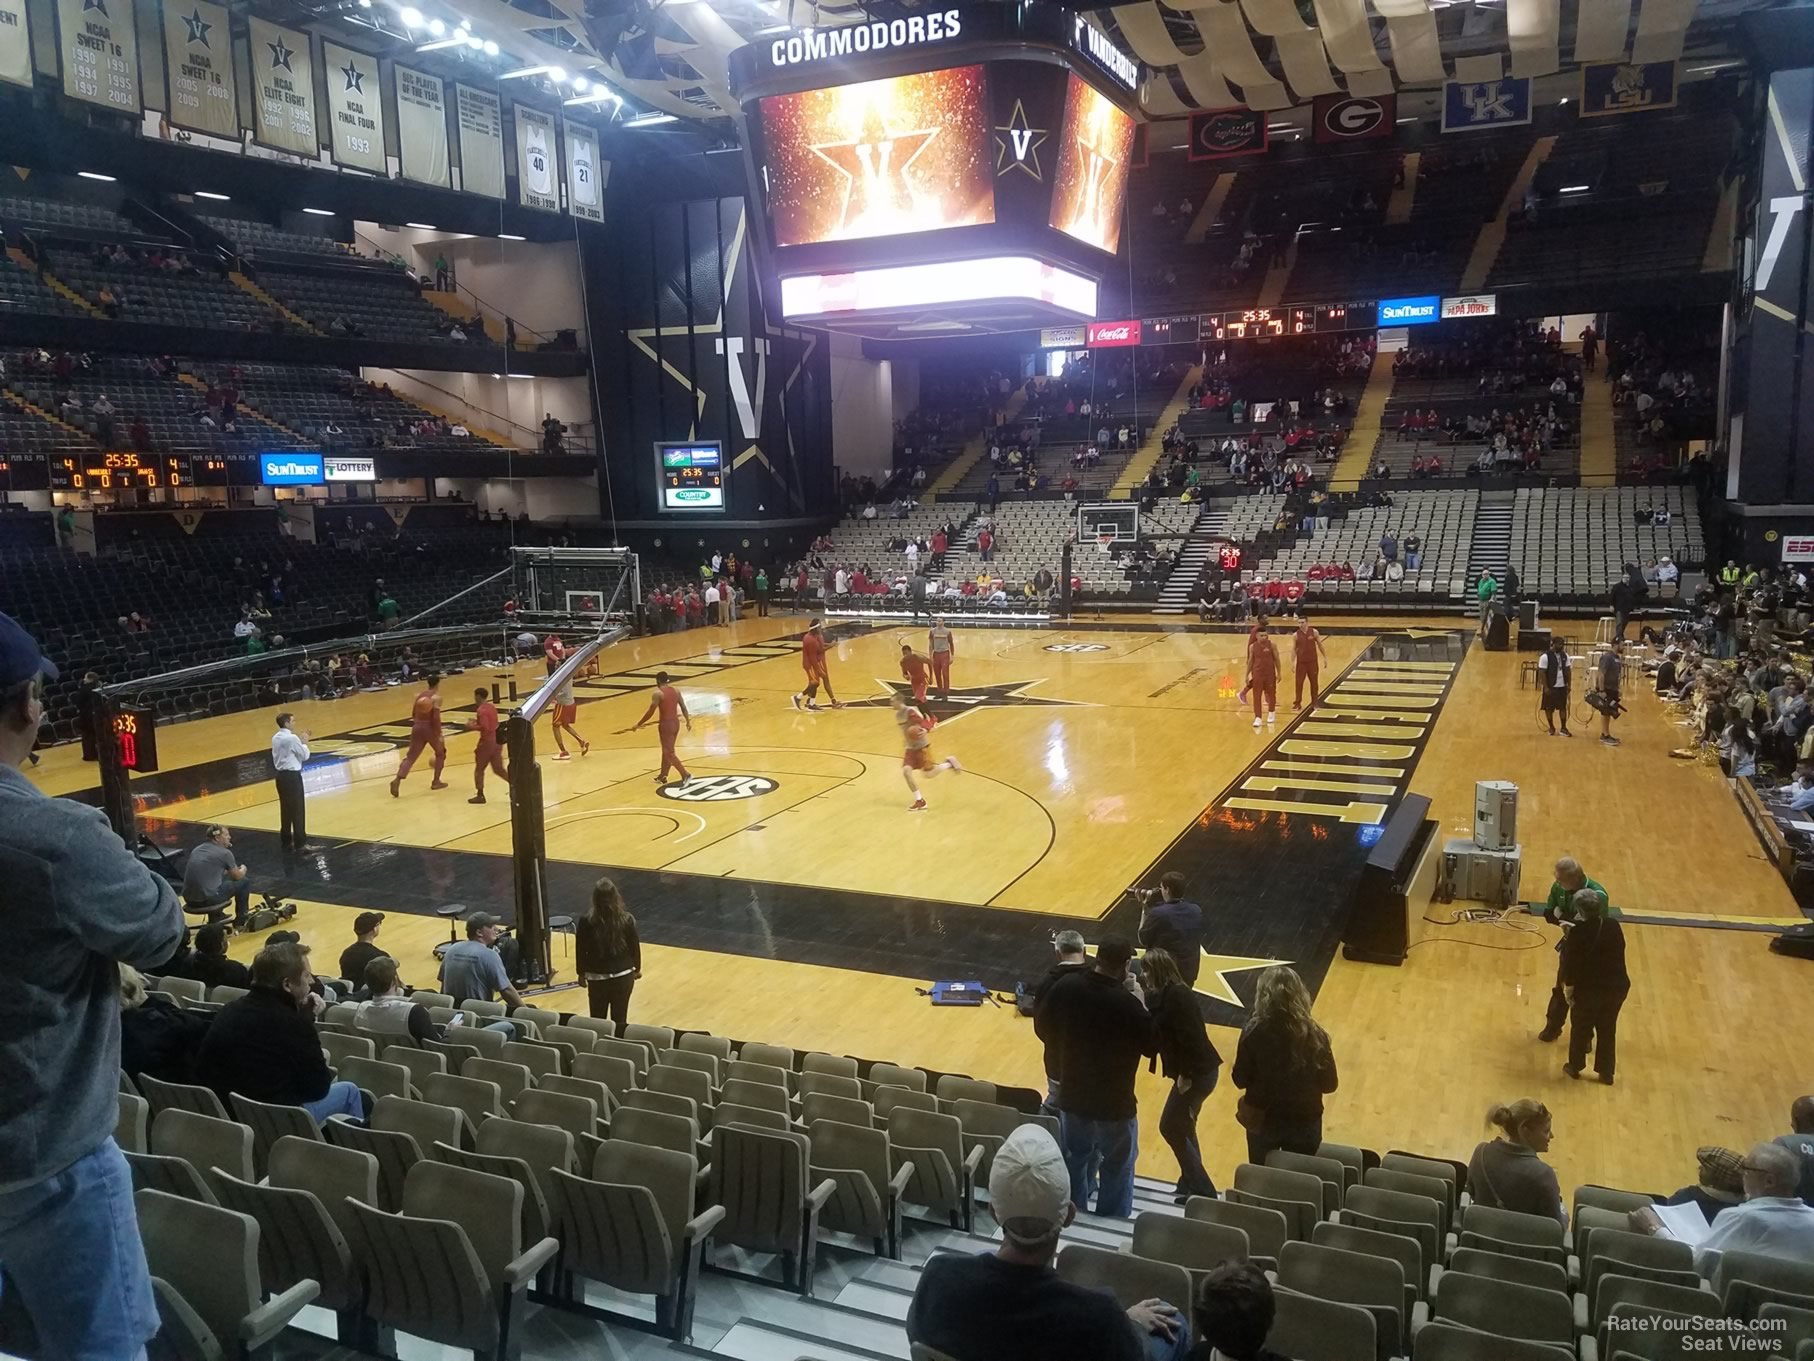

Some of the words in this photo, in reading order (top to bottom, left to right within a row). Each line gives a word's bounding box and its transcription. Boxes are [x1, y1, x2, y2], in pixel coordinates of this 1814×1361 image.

[85, 22, 111, 40] NCAA
[771, 9, 961, 66] COMMODORES
[77, 33, 105, 52] SWEET
[110, 43, 122, 57] 16
[72, 47, 96, 64] 1990
[107, 57, 129, 73] 1991
[189, 53, 212, 69] NCAA
[1088, 24, 1137, 90] VANDERBILT
[73, 63, 97, 80] 1994
[108, 74, 132, 90] 1995
[182, 64, 206, 80] SWEET
[210, 72, 221, 84] 16
[176, 77, 198, 91] 2005
[273, 76, 294, 92] NCAA
[75, 80, 97, 96] 1997
[108, 89, 133, 106] 2004
[264, 86, 282, 101] ELITE
[285, 93, 305, 107] EIGHT
[1604, 88, 1653, 109] LSU
[346, 100, 364, 114] NCAA
[1460, 81, 1514, 122] UK
[338, 111, 356, 126] FINAL
[358, 117, 375, 131] FOUR
[346, 135, 370, 154] 1993
[1009, 129, 1033, 162] V
[533, 157, 544, 172] 40
[579, 169, 588, 183] 21
[1243, 310, 1270, 321] 25:35
[1296, 311, 1303, 320] 4
[1383, 304, 1434, 319] SUNTRUST
[1447, 304, 1465, 316] PAPA
[1211, 318, 1218, 327] 4
[1296, 322, 1303, 333] 0
[1216, 328, 1223, 338] 0
[1237, 327, 1244, 337] 0
[1276, 325, 1283, 335] 0
[715, 337, 770, 439] V
[64, 459, 73, 470] 4
[106, 454, 139, 467] 25:35
[170, 459, 178, 470] 4
[337, 463, 373, 472] LOTTERY
[267, 463, 318, 476] SUNTRUST
[683, 468, 703, 477] 25:35
[73, 474, 82, 487] 0
[101, 475, 110, 487] 0
[124, 477, 128, 486] 1
[148, 474, 156, 486] 0
[171, 473, 179, 485] 0
[672, 477, 678, 486] 0
[714, 476, 720, 485] 0
[183, 514, 195, 527] D
[1786, 540, 1814, 552] ES
[1224, 556, 1237, 568] 30
[1045, 643, 1107, 653] SEC
[664, 776, 772, 800] SEC
